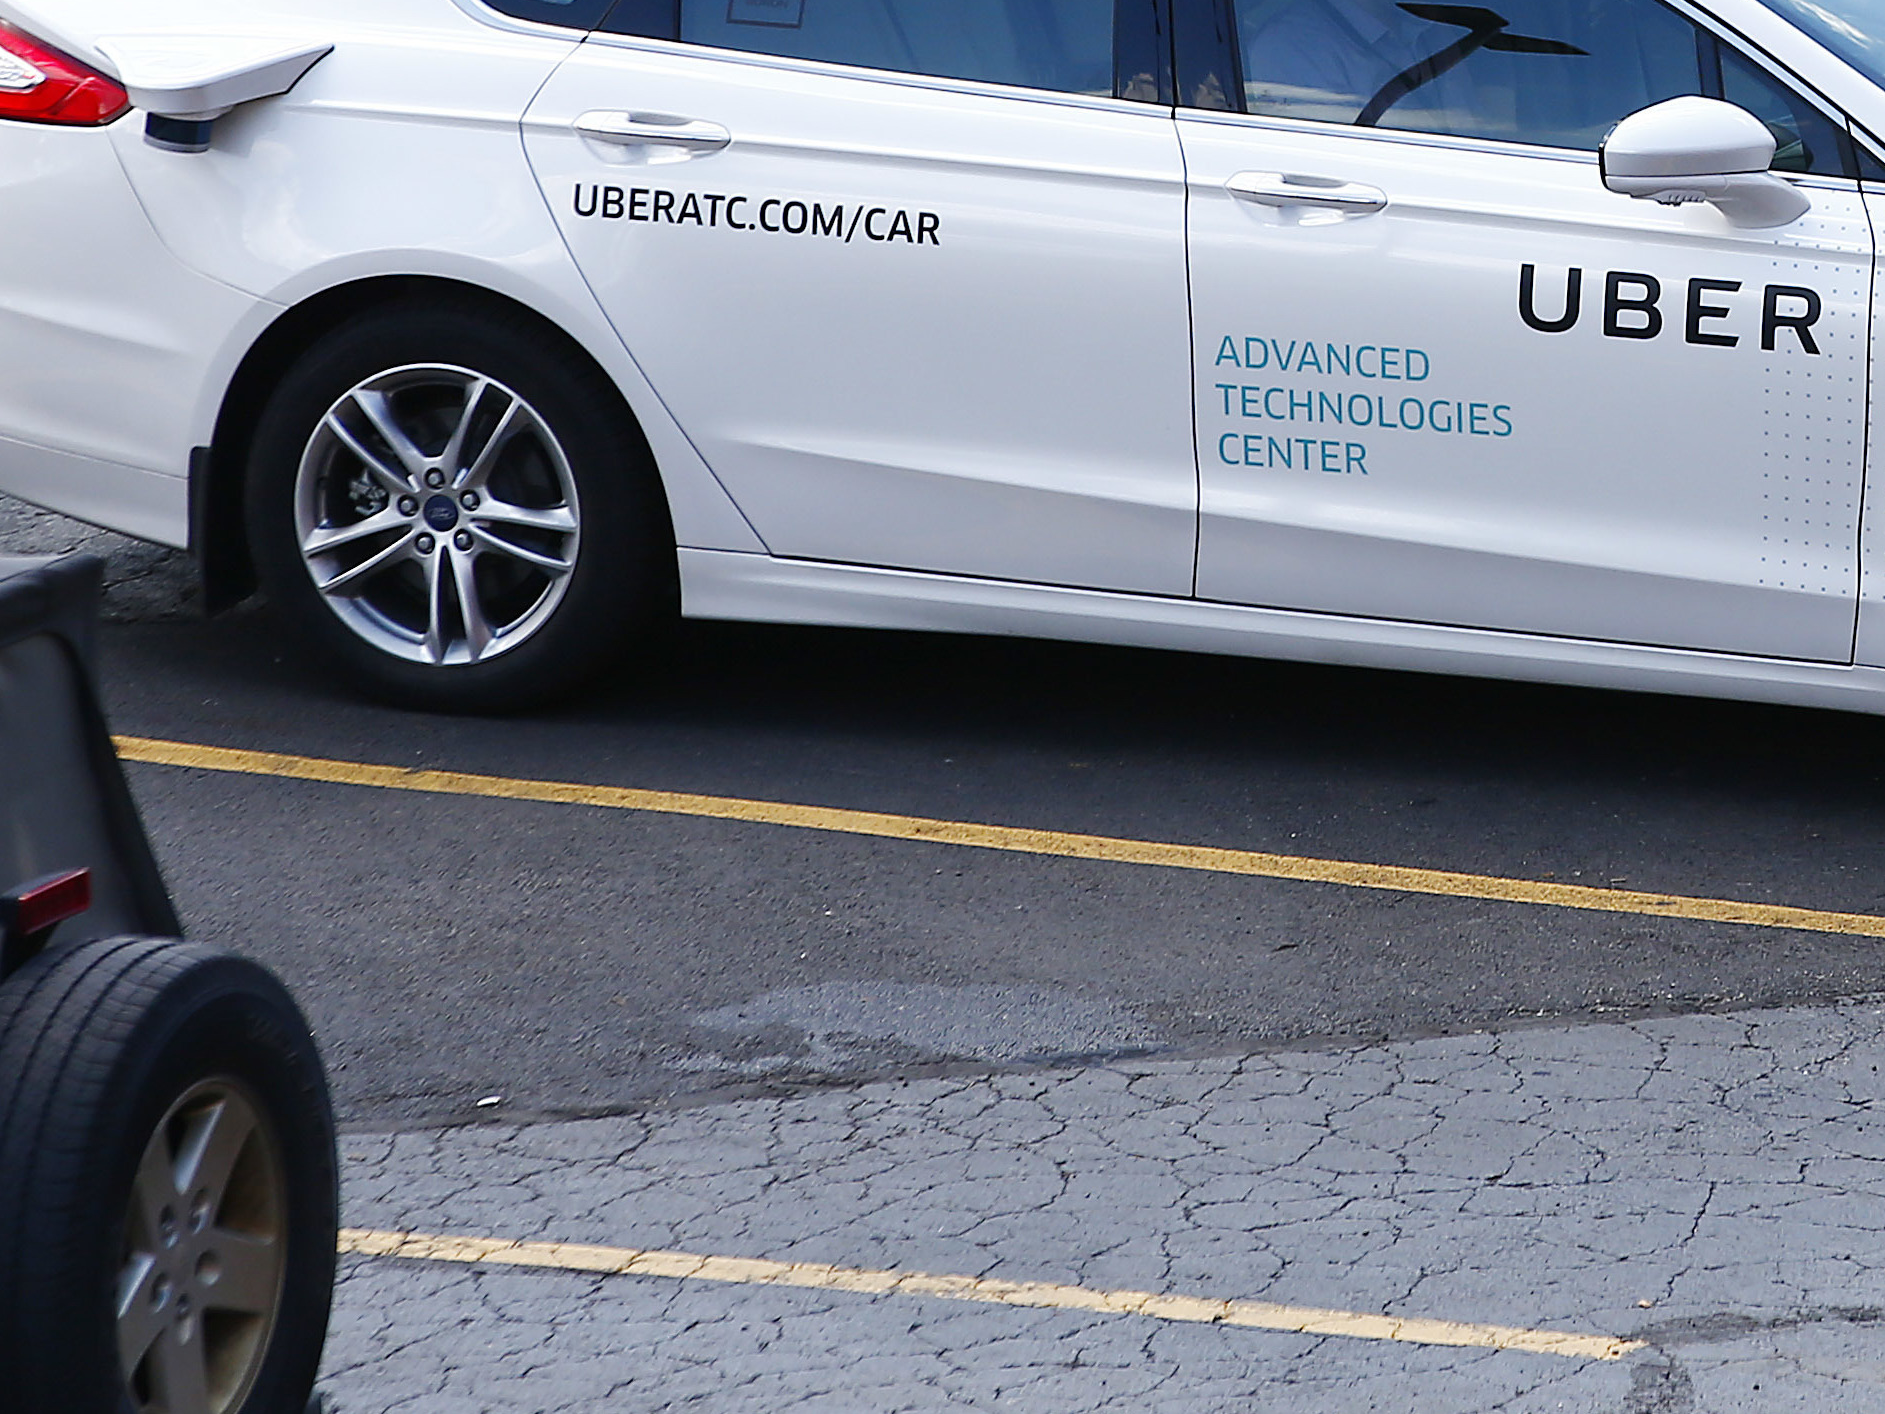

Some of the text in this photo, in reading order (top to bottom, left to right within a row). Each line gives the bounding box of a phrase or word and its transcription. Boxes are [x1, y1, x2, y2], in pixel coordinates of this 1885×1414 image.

[574, 183, 940, 246] UBERATC.COM/CAR
[1518, 263, 1822, 355] UBER
[1215, 334, 1430, 382] ADVANCED
[1214, 383, 1513, 437] TECHNOLOGIES
[1219, 432, 1368, 475] CENTER
